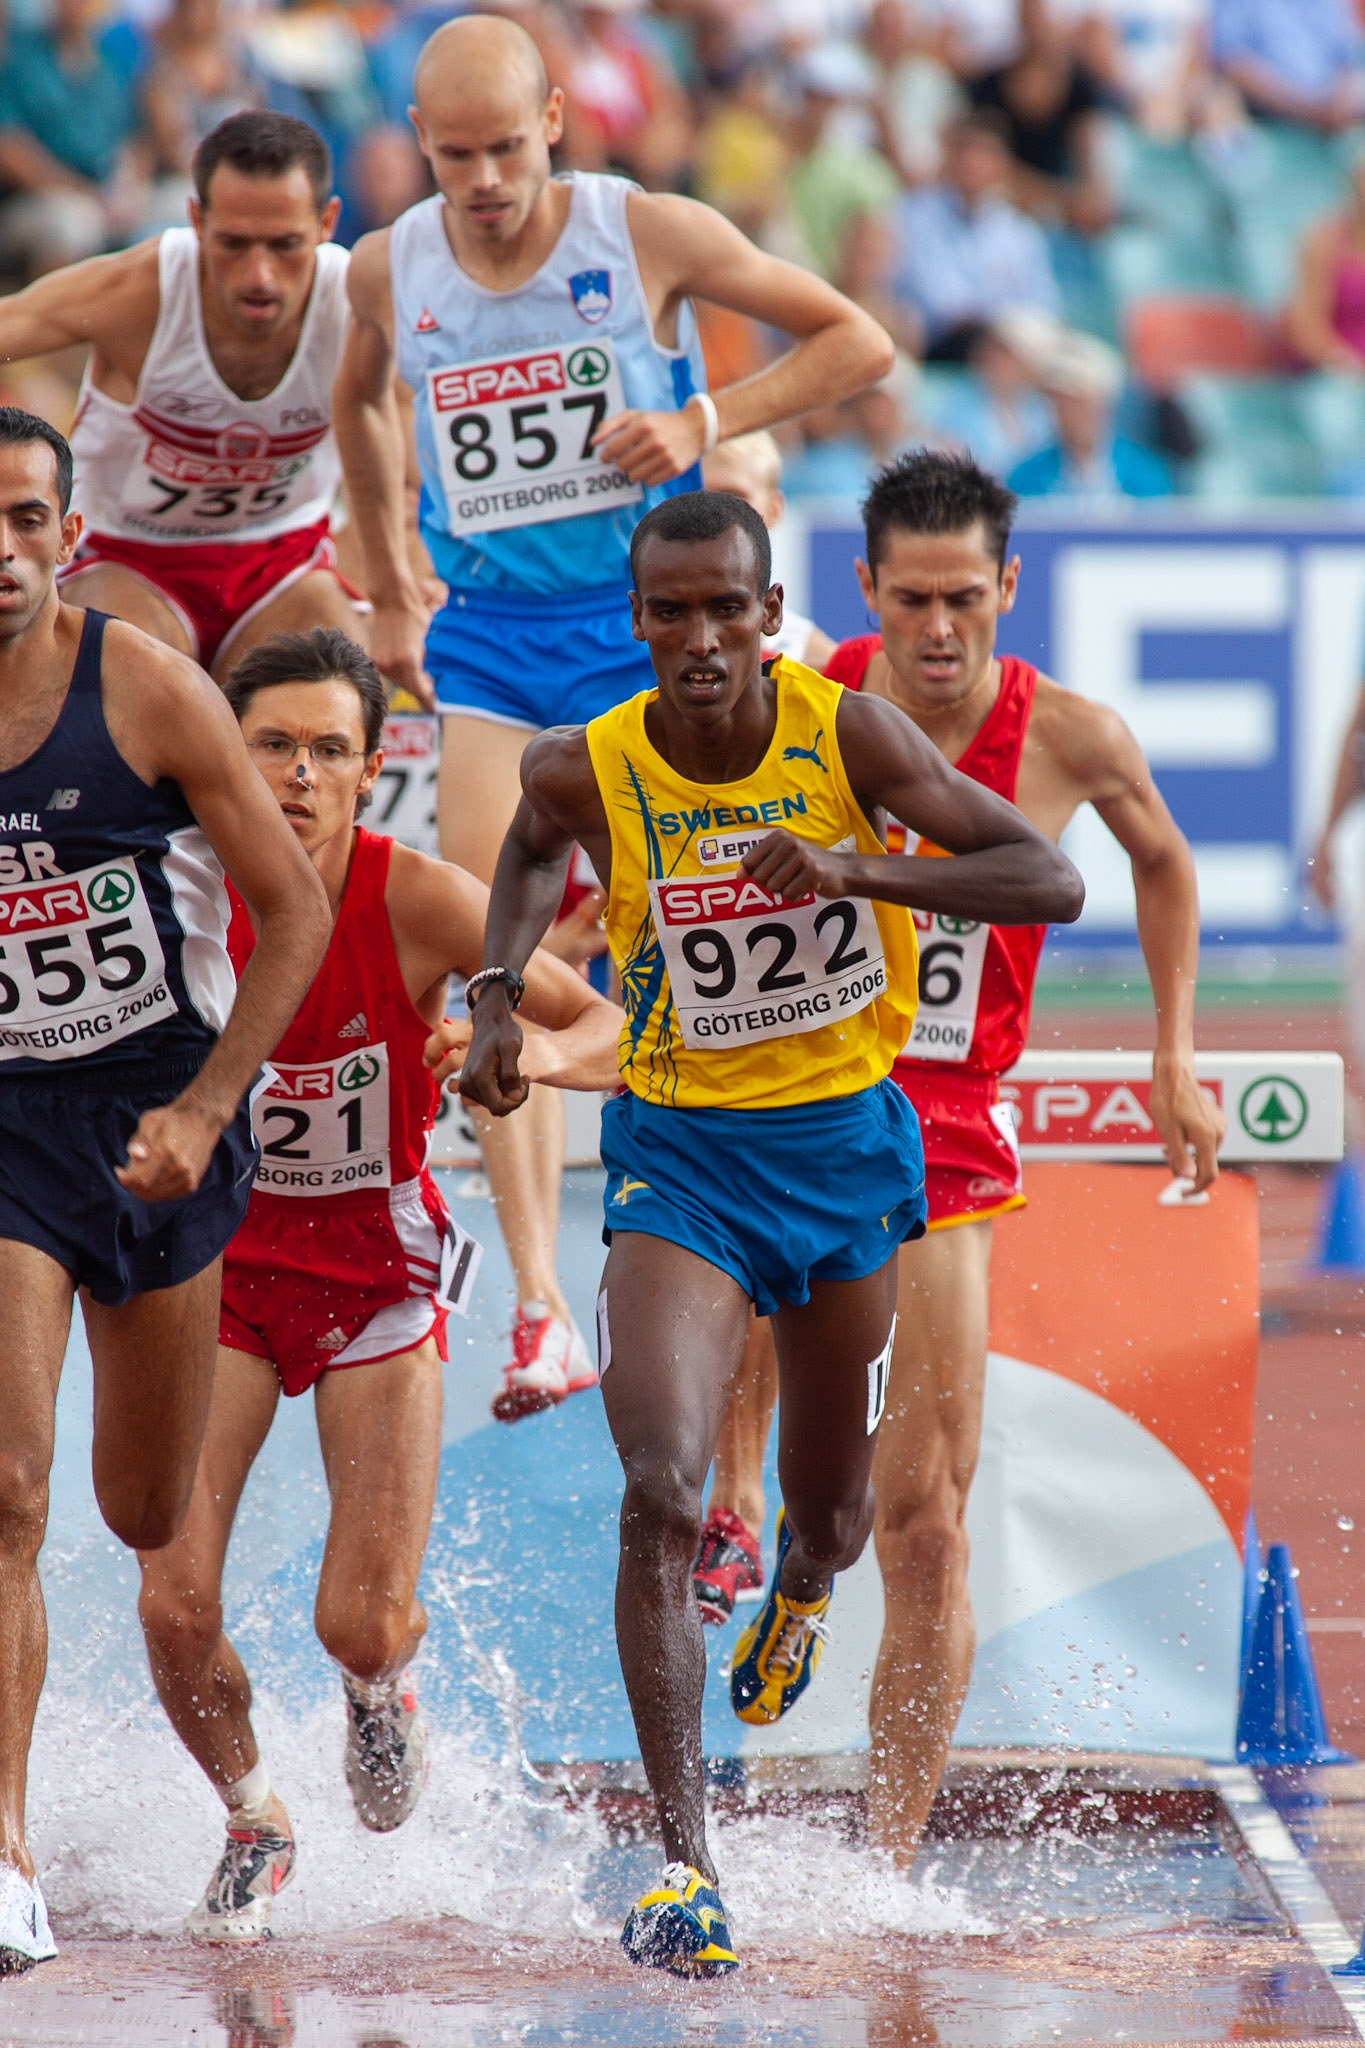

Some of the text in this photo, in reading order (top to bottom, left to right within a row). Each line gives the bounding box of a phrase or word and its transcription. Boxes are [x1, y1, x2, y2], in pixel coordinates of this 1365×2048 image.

[437, 357, 563, 407] SPAR
[449, 391, 607, 481] 857
[149, 442, 273, 480] SPAR
[150, 476, 291, 517] 735
[457, 480, 579, 520] GÖTEBORG
[0, 812, 42, 832] RAEL
[659, 792, 808, 835] SWEDEN
[0, 841, 66, 885] SR
[681, 900, 868, 999] 922
[918, 941, 964, 1007] 6
[0, 983, 168, 1049] ÖTEBORG 2006
[693, 968, 884, 1037] GÖTEBORG 2006
[914, 1023, 967, 1047] 2006
[263, 1096, 362, 1160] 21
[998, 1085, 1218, 1133] SPA
[256, 1160, 384, 1187] BORG 2006
